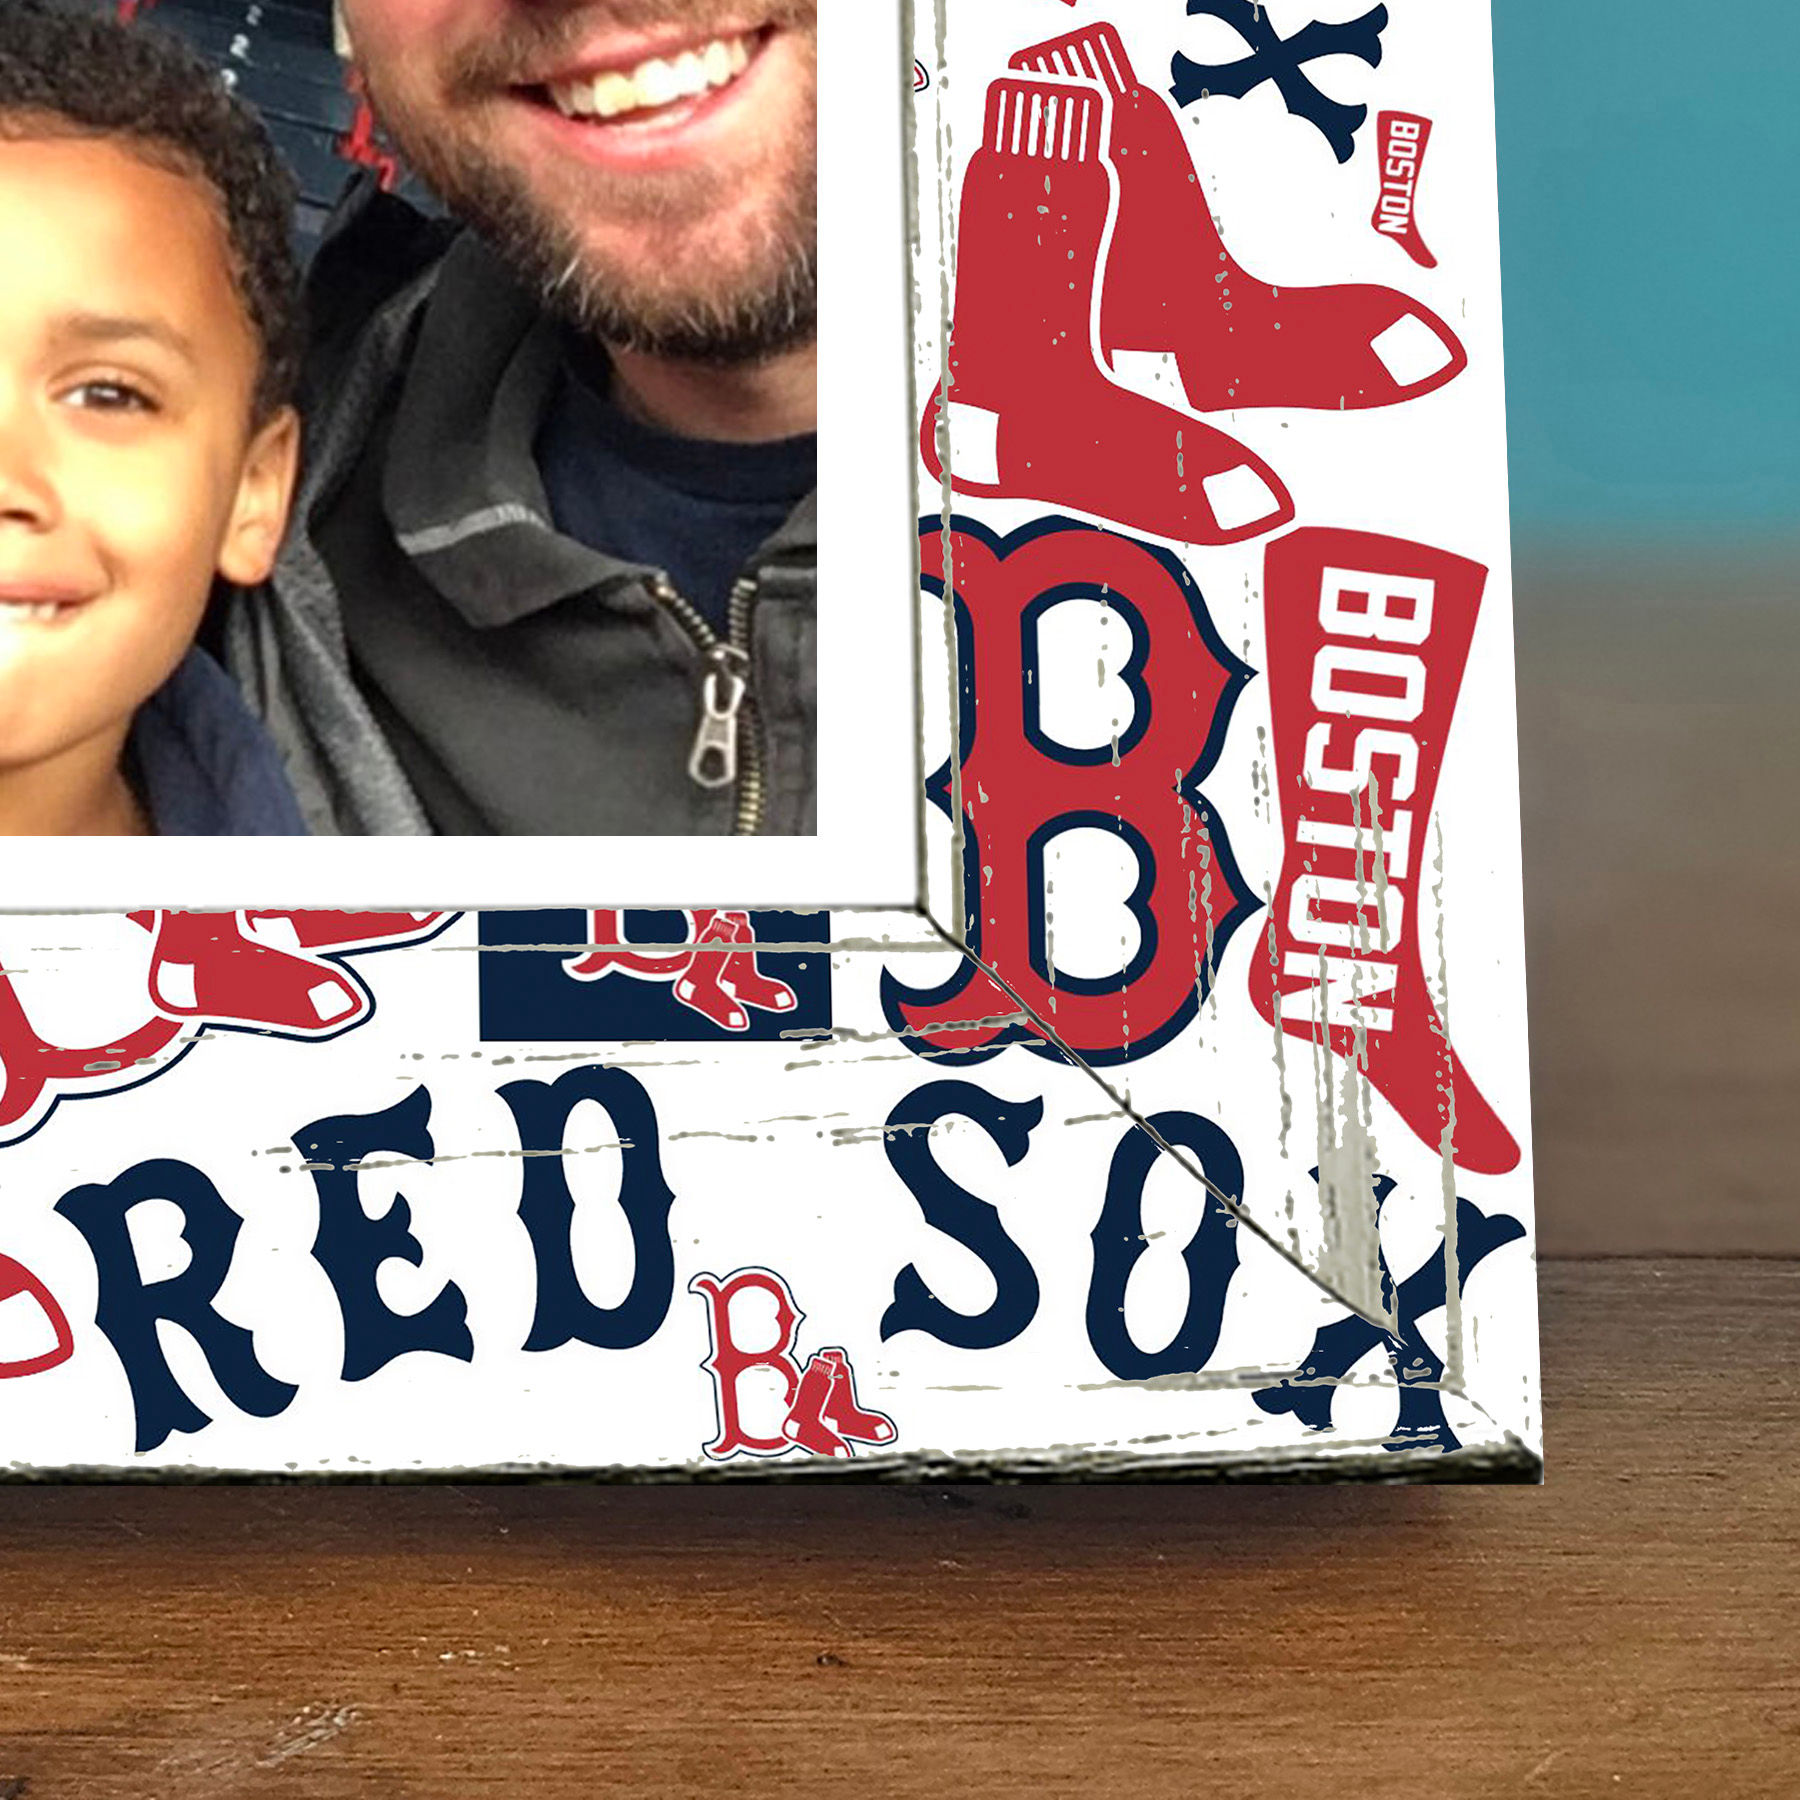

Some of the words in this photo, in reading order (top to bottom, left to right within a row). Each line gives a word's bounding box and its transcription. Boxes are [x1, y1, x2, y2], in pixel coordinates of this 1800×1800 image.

[1378, 119, 1421, 235] BOSTON
[1284, 566, 1436, 1033] BOSTON
[53, 1063, 677, 1453] RED
[880, 1079, 1528, 1455] SOX
